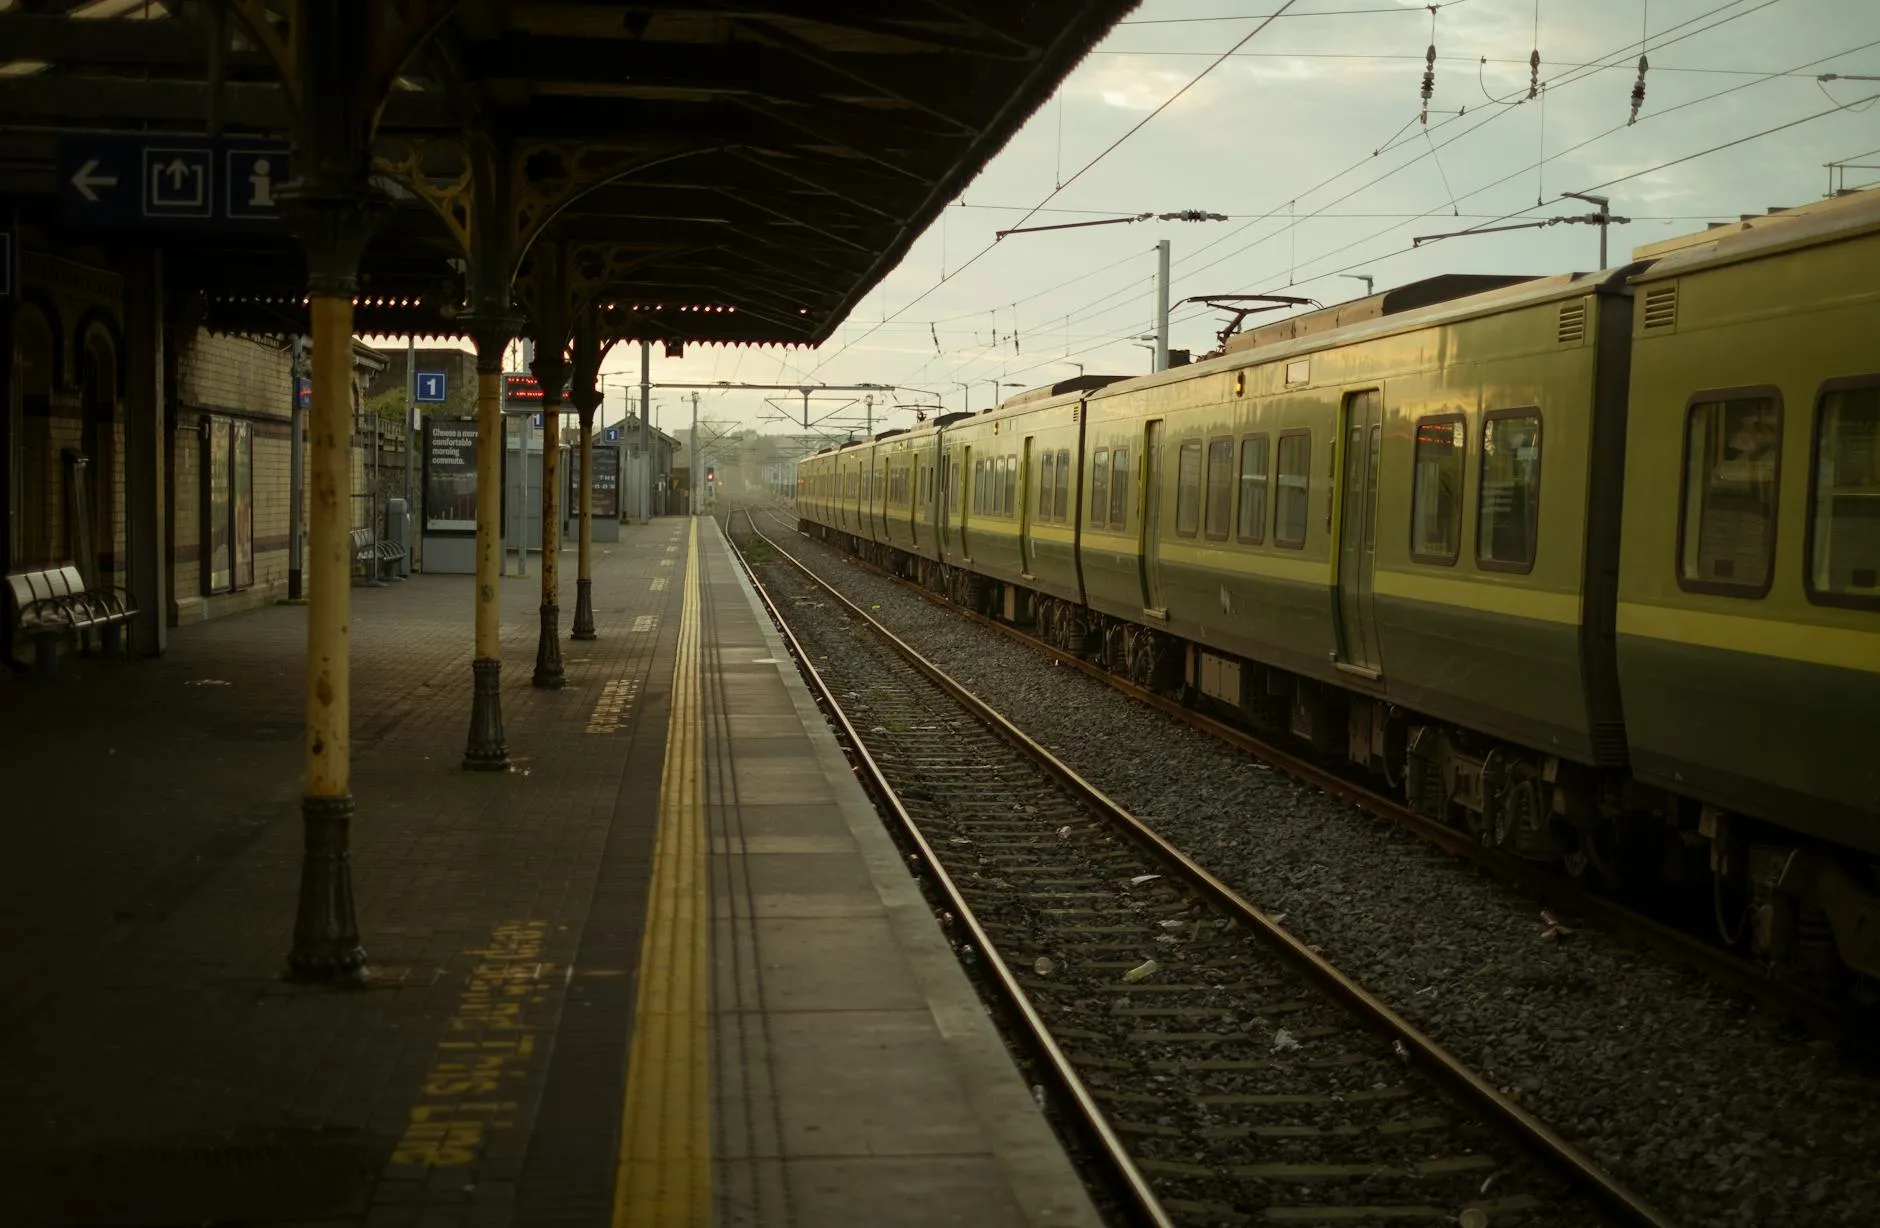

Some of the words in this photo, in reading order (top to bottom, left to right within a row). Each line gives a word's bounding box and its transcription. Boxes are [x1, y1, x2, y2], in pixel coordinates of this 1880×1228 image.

[426, 378, 436, 396] 1
[432, 427, 456, 437] Choose
[609, 431, 615, 440] 1
[432, 438, 472, 447] comfortable
[432, 447, 460, 456] morning
[422, 1035, 536, 1096] This
[389, 1101, 518, 1165] Line
